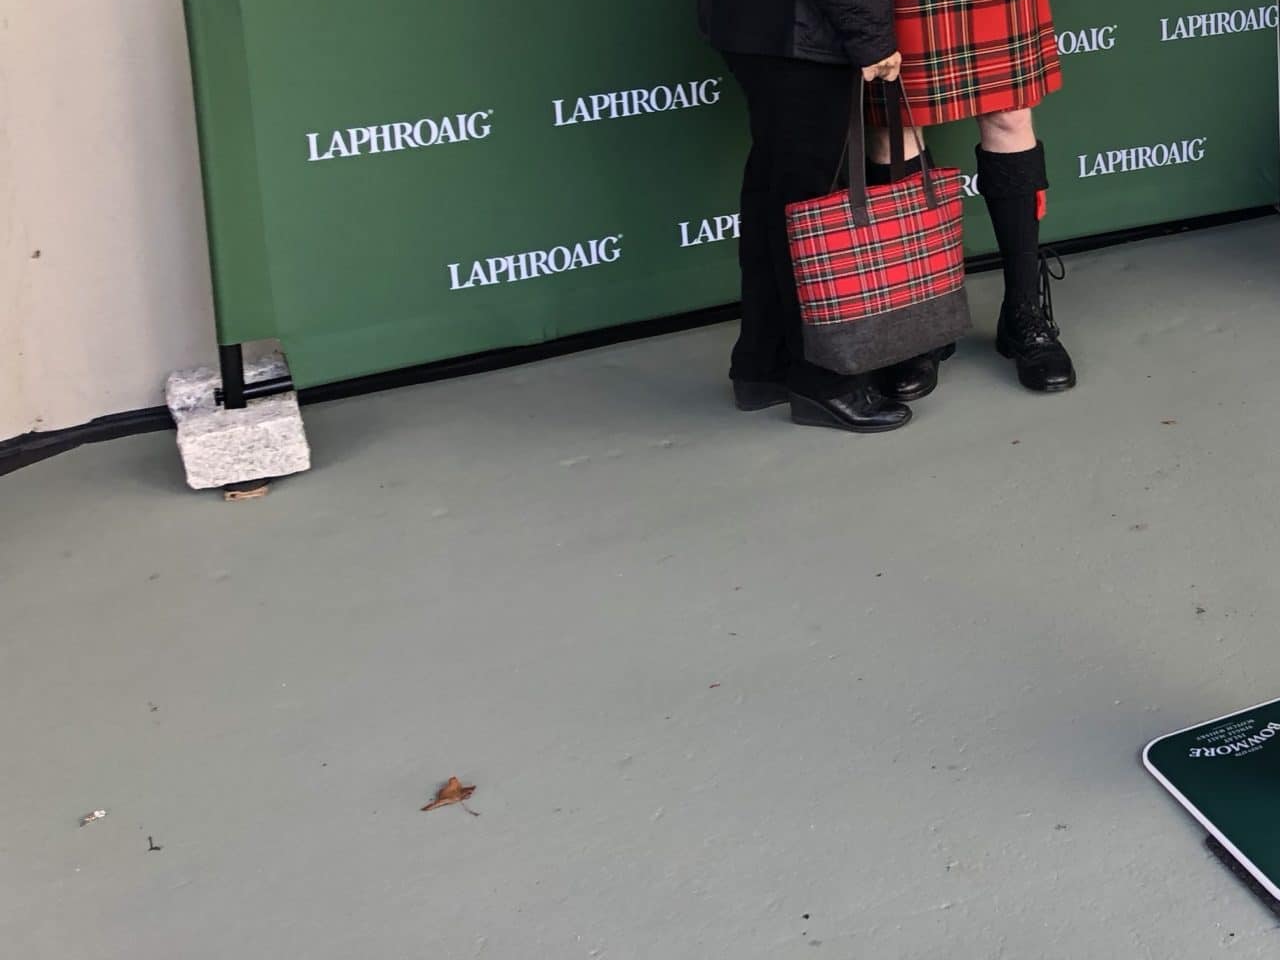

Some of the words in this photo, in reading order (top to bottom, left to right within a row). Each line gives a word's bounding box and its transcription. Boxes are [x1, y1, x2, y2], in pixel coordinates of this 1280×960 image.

[552, 78, 720, 127] LAPHROAIG
[306, 108, 494, 162] LAPHROAIG
[1078, 136, 1207, 178] LAPHROAIG
[447, 233, 623, 291] LAPHROAIG
